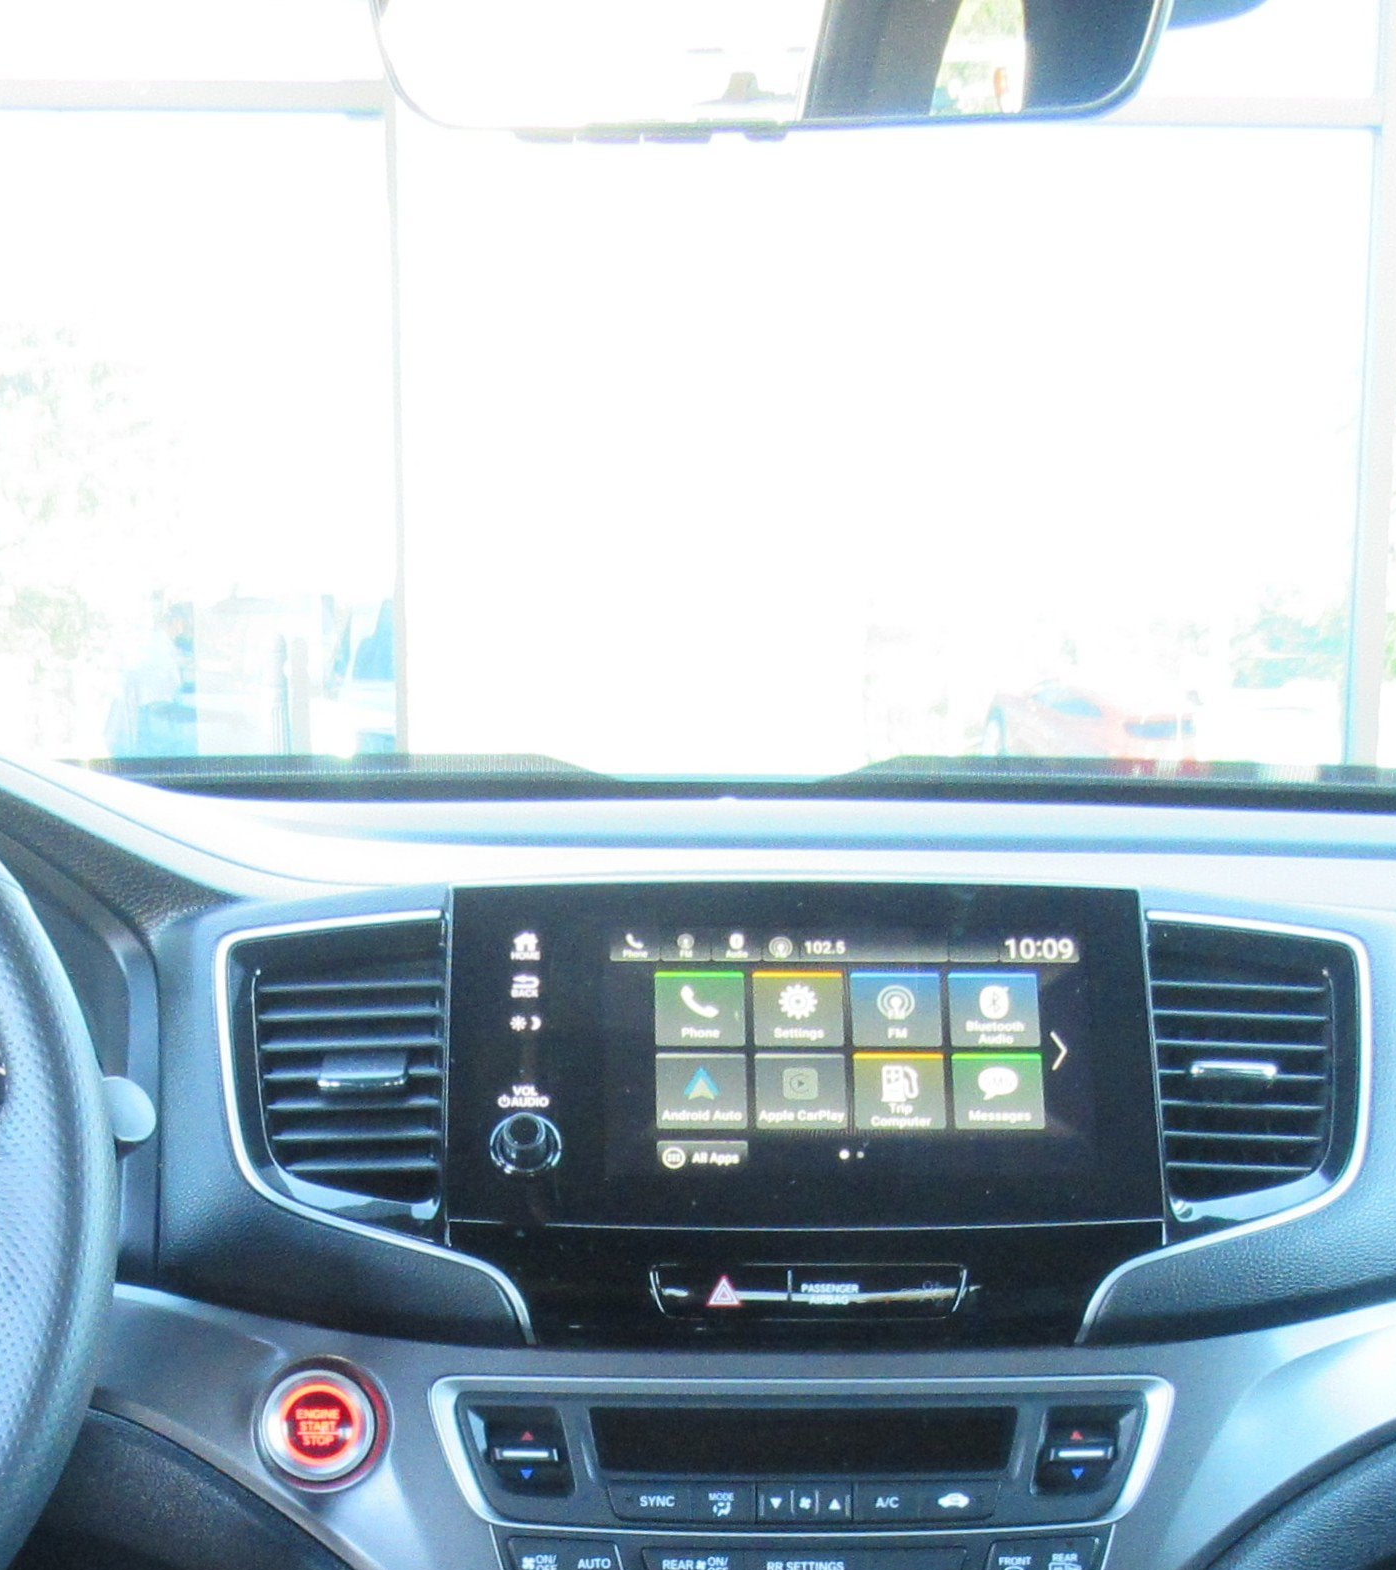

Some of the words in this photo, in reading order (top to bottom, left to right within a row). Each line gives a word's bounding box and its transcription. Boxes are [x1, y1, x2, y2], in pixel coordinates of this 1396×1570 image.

[804, 940, 846, 955] 102.5
[1005, 937, 1074, 959] 10:09
[510, 950, 541, 961] HOME
[511, 988, 539, 998] BACK
[965, 1020, 1025, 1032] Bluetooth
[681, 1027, 721, 1039] Phone
[773, 1026, 825, 1041] Settings
[888, 1027, 909, 1039] FM
[978, 1033, 1014, 1045] Audio
[512, 1085, 538, 1097] VOL
[511, 1096, 550, 1108] AUDIO
[888, 1102, 914, 1116] Trip
[661, 1109, 710, 1122] Android
[712, 1109, 743, 1122] Auto
[758, 1109, 795, 1124] Apple
[797, 1109, 846, 1124] CarPlay
[968, 1110, 1032, 1124] Messages
[870, 1115, 933, 1129] Computer
[691, 1152, 708, 1165] All
[710, 1152, 740, 1167] Apps
[800, 1283, 859, 1294] PASSENGER
[295, 1409, 341, 1420] ENGINE
[300, 1420, 337, 1432] START
[302, 1435, 335, 1446] STOP
[639, 1495, 675, 1507] SYNC
[708, 1492, 735, 1501] MODE
[875, 1496, 900, 1509] A/C
[535, 1554, 557, 1564] ON/
[577, 1558, 612, 1570] AUTO
[707, 1556, 729, 1566] ON/
[998, 1556, 1031, 1565] FRONT
[1052, 1553, 1078, 1563] REAR
[662, 1559, 694, 1570] REAR
